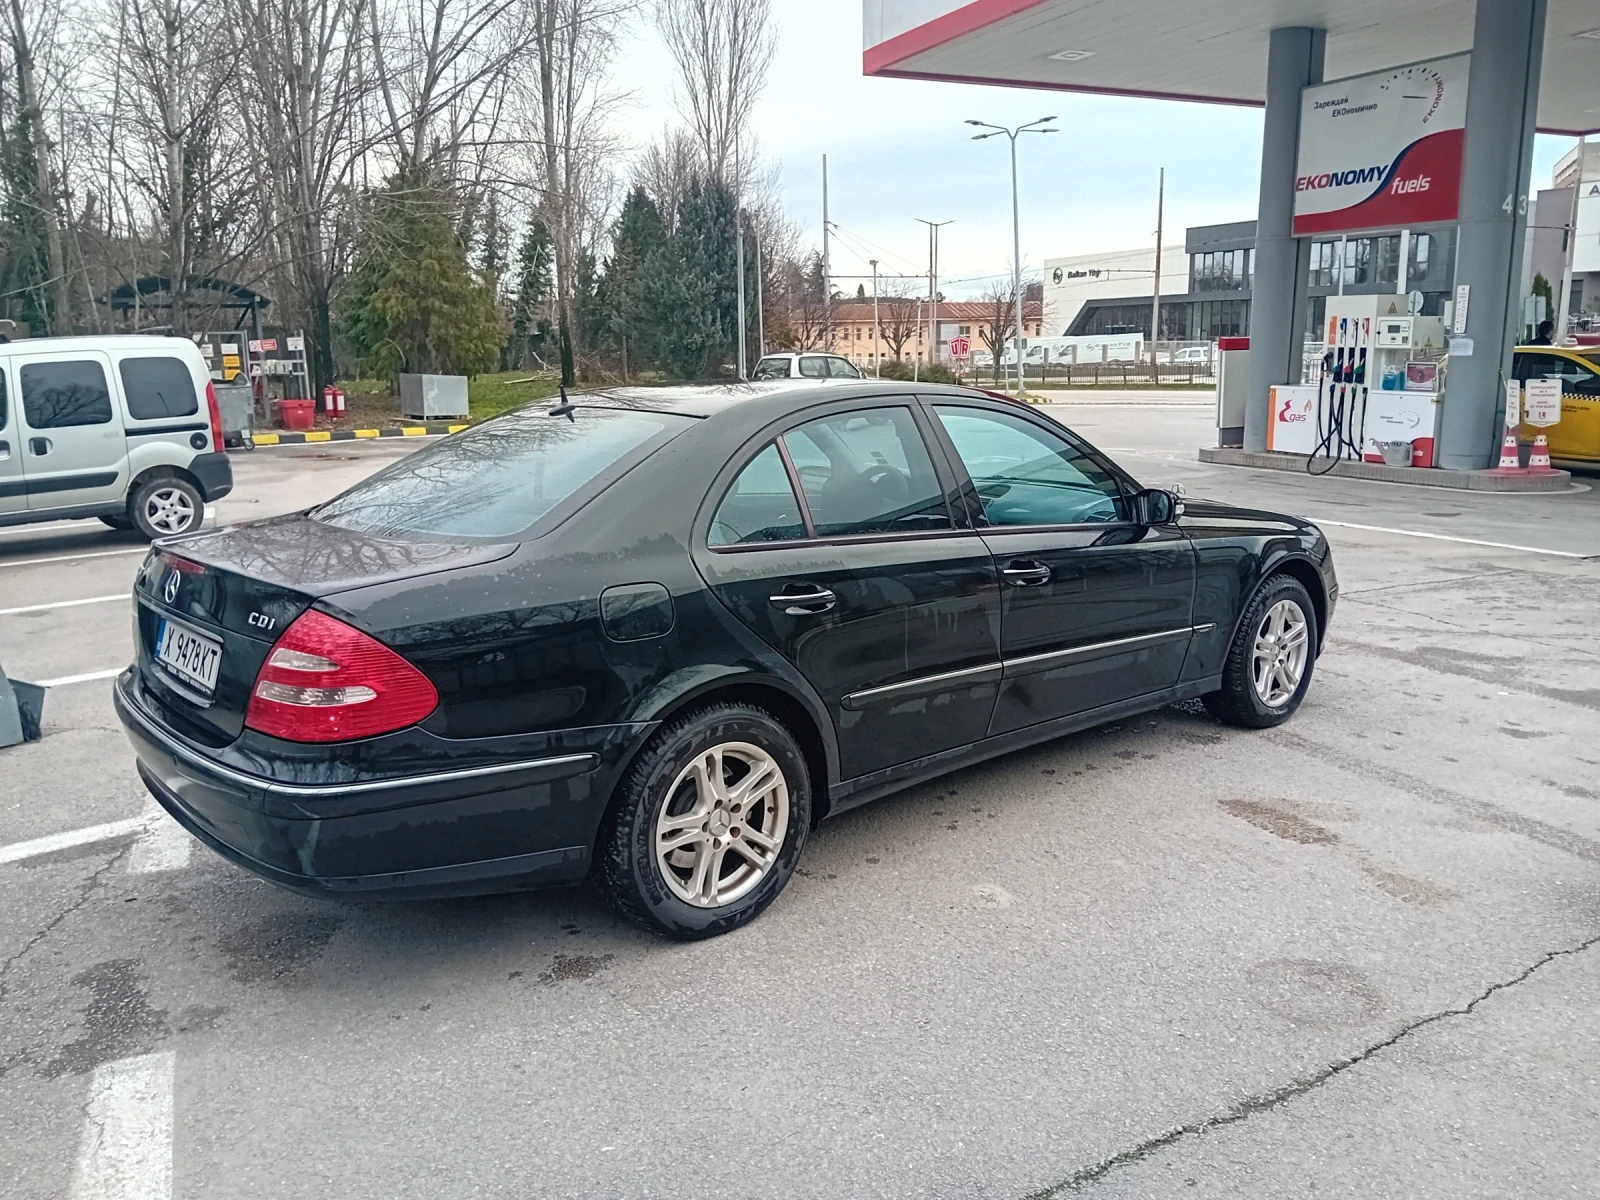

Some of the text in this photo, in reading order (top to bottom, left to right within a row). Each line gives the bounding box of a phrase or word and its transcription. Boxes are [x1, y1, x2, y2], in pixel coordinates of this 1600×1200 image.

[1313, 95, 1349, 110] Зареждай
[1331, 103, 1378, 118] ЕКОномично
[1296, 164, 1432, 195] EKONOMY fuels
[1501, 193, 1513, 214] 4
[1518, 194, 1528, 215] 3
[248, 611, 276, 630] CDI
[164, 626, 175, 658] X
[176, 633, 218, 682] 9478KT
